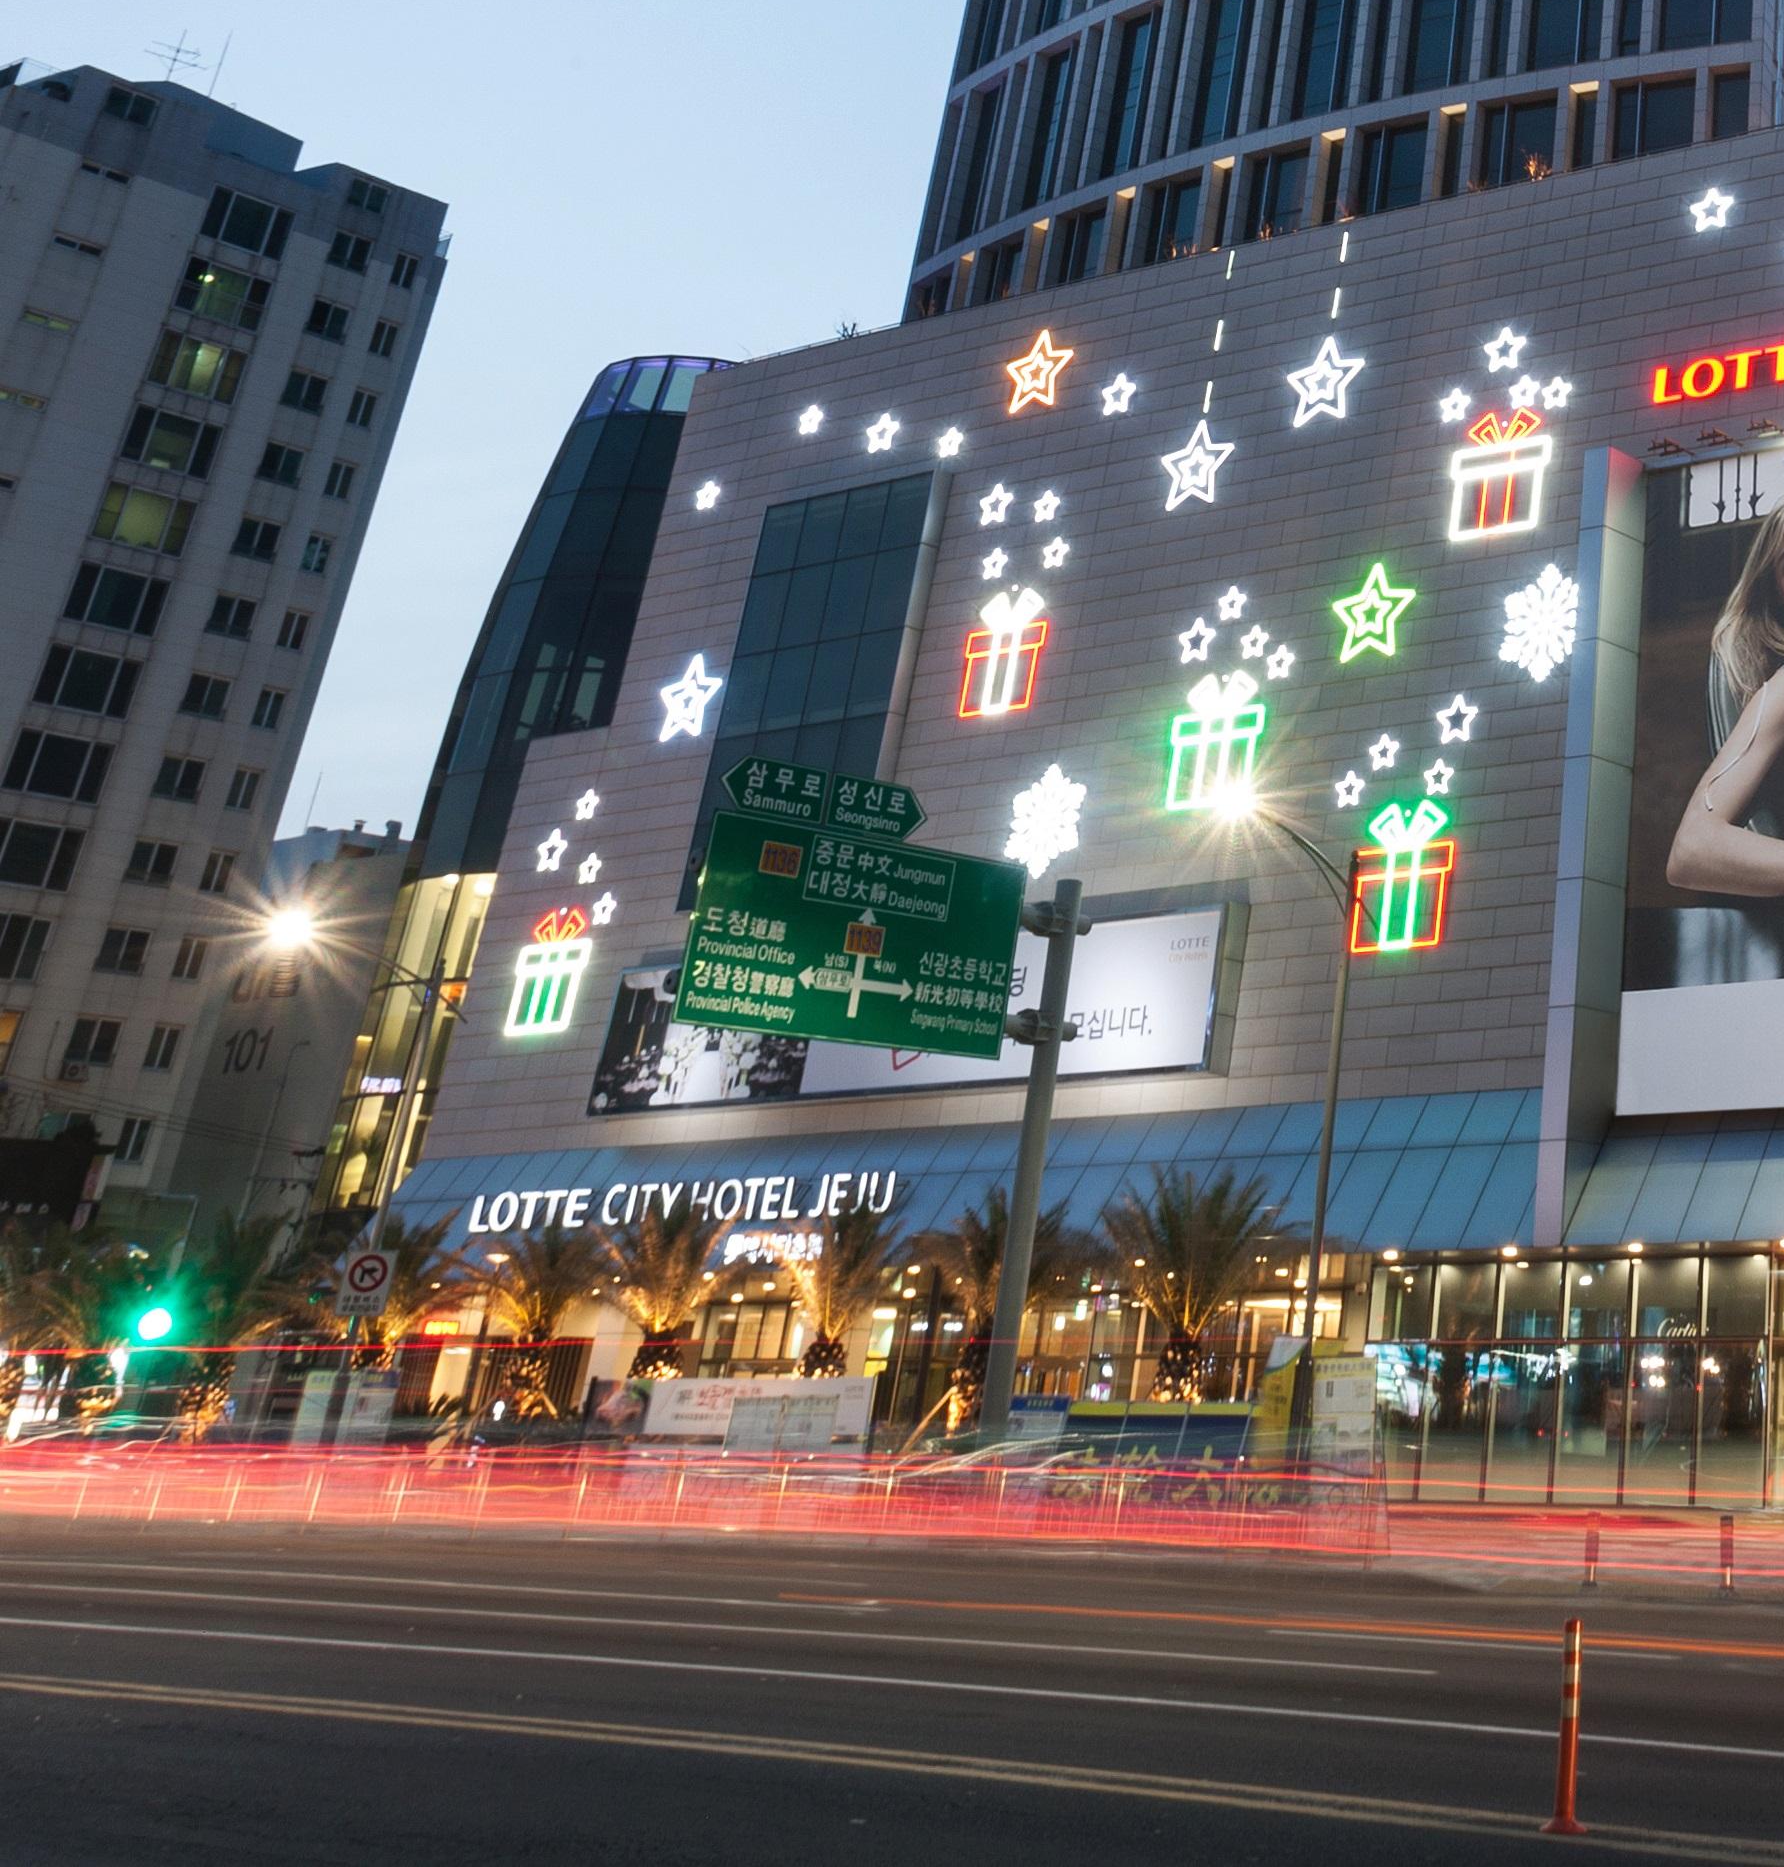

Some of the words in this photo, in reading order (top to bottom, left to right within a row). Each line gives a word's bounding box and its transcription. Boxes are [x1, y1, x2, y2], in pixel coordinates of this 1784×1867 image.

[742, 788, 812, 817] Sammuro
[835, 806, 900, 833] Seongsinro
[893, 863, 946, 886] Jungmun
[888, 891, 947, 918] Daejeong
[697, 936, 757, 959] Provincial
[757, 944, 796, 965] Office
[1170, 936, 1210, 950] LOTTE
[685, 990, 732, 1013] Provincial
[732, 996, 761, 1016] Police
[761, 1000, 796, 1024] Agency
[946, 1014, 973, 1036] Primary
[974, 1018, 998, 1036] School
[222, 1026, 274, 1074] 101
[468, 1188, 592, 1232] LOTTE
[602, 1181, 684, 1226] CITY
[690, 1176, 798, 1222] HOTEL
[809, 1170, 896, 1217] JEJU
